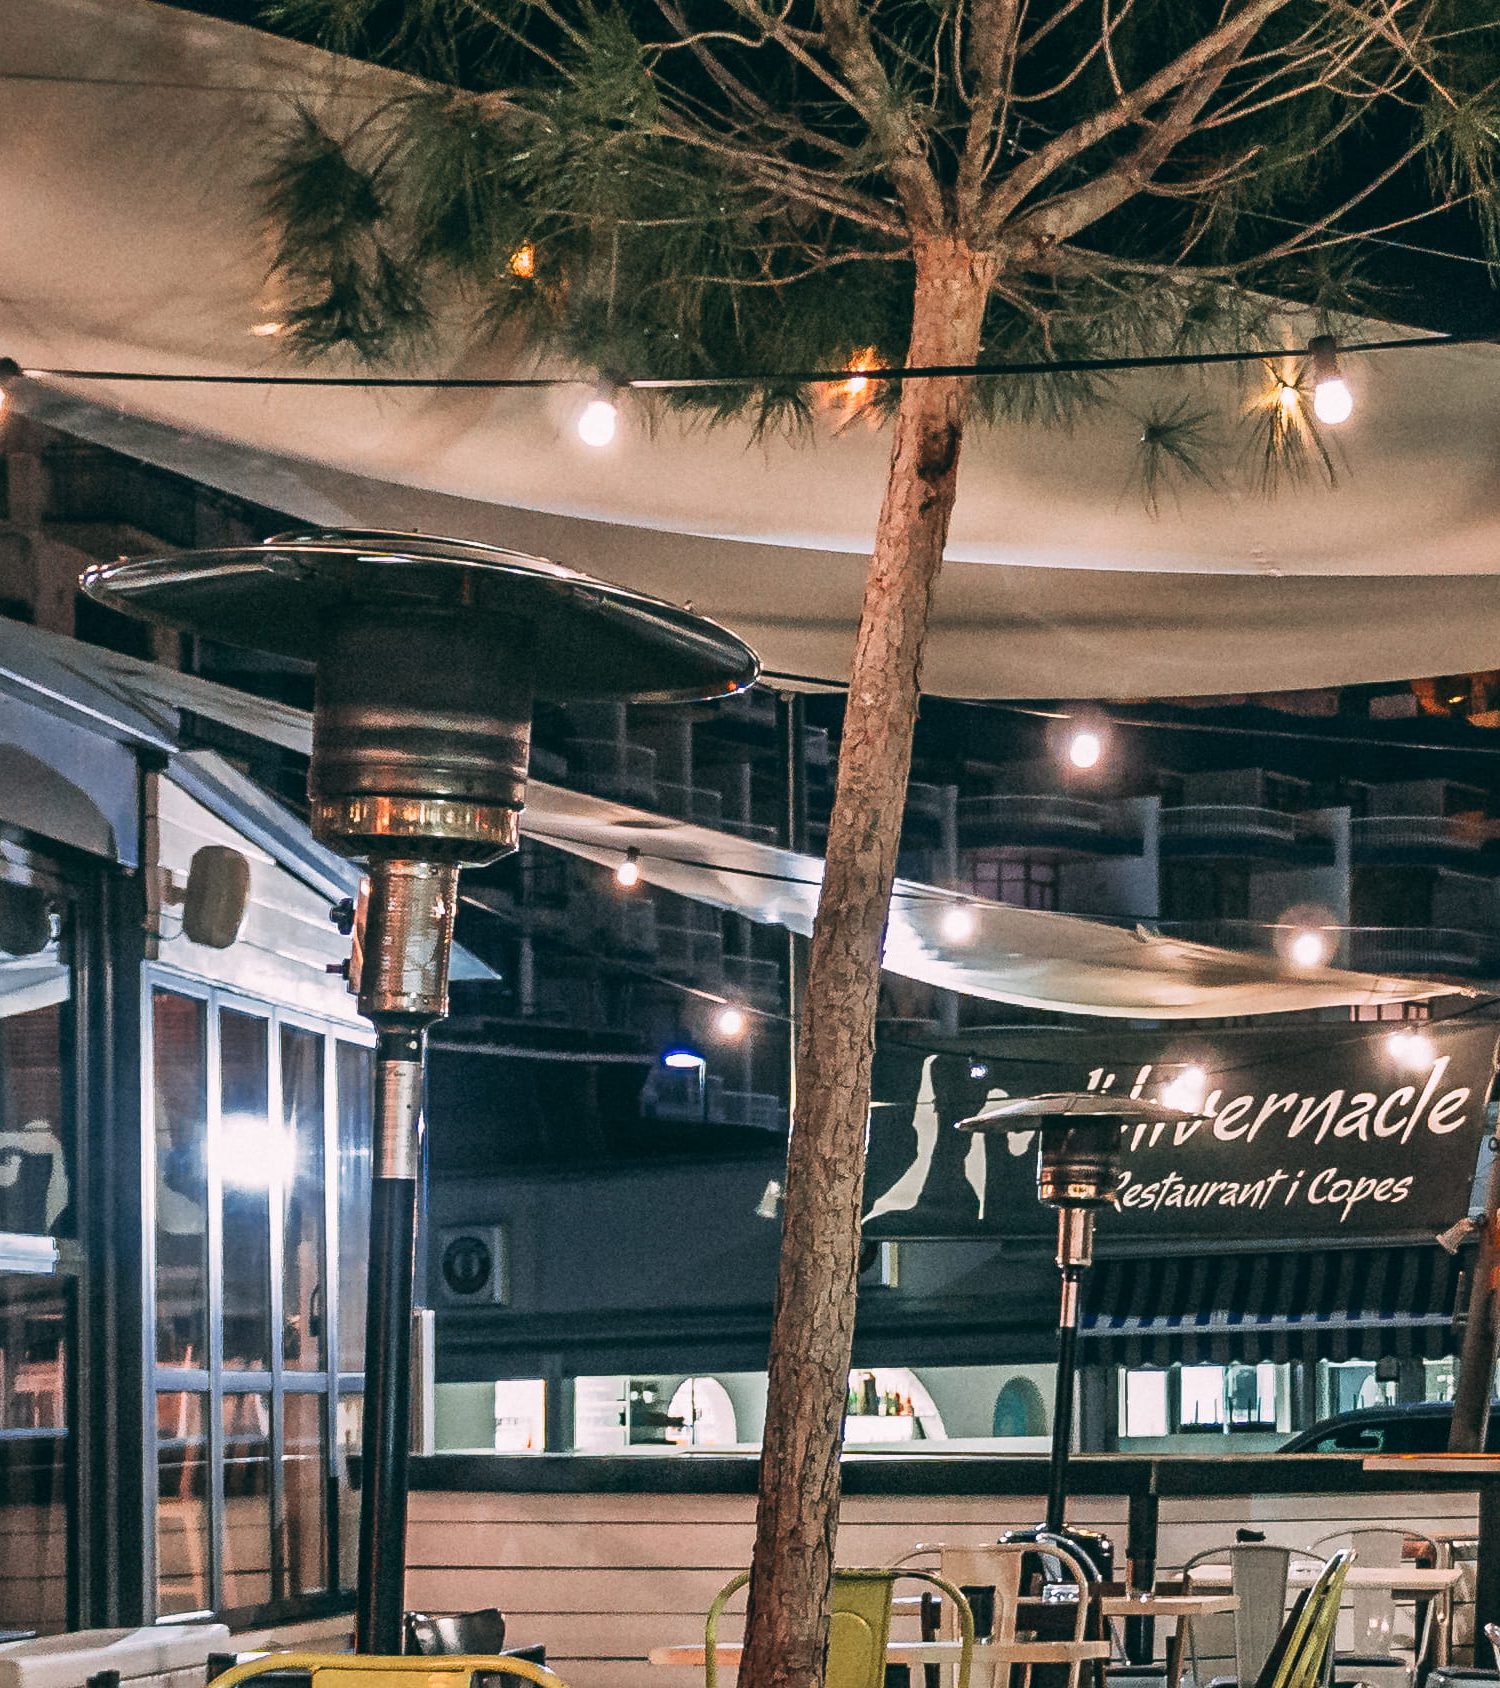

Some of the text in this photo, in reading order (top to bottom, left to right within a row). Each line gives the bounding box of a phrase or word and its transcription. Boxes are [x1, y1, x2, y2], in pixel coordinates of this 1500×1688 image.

[1087, 1055, 1471, 1153] 'vernacle
[1286, 1170, 1305, 1206] i
[1308, 1168, 1414, 1222] Copes
